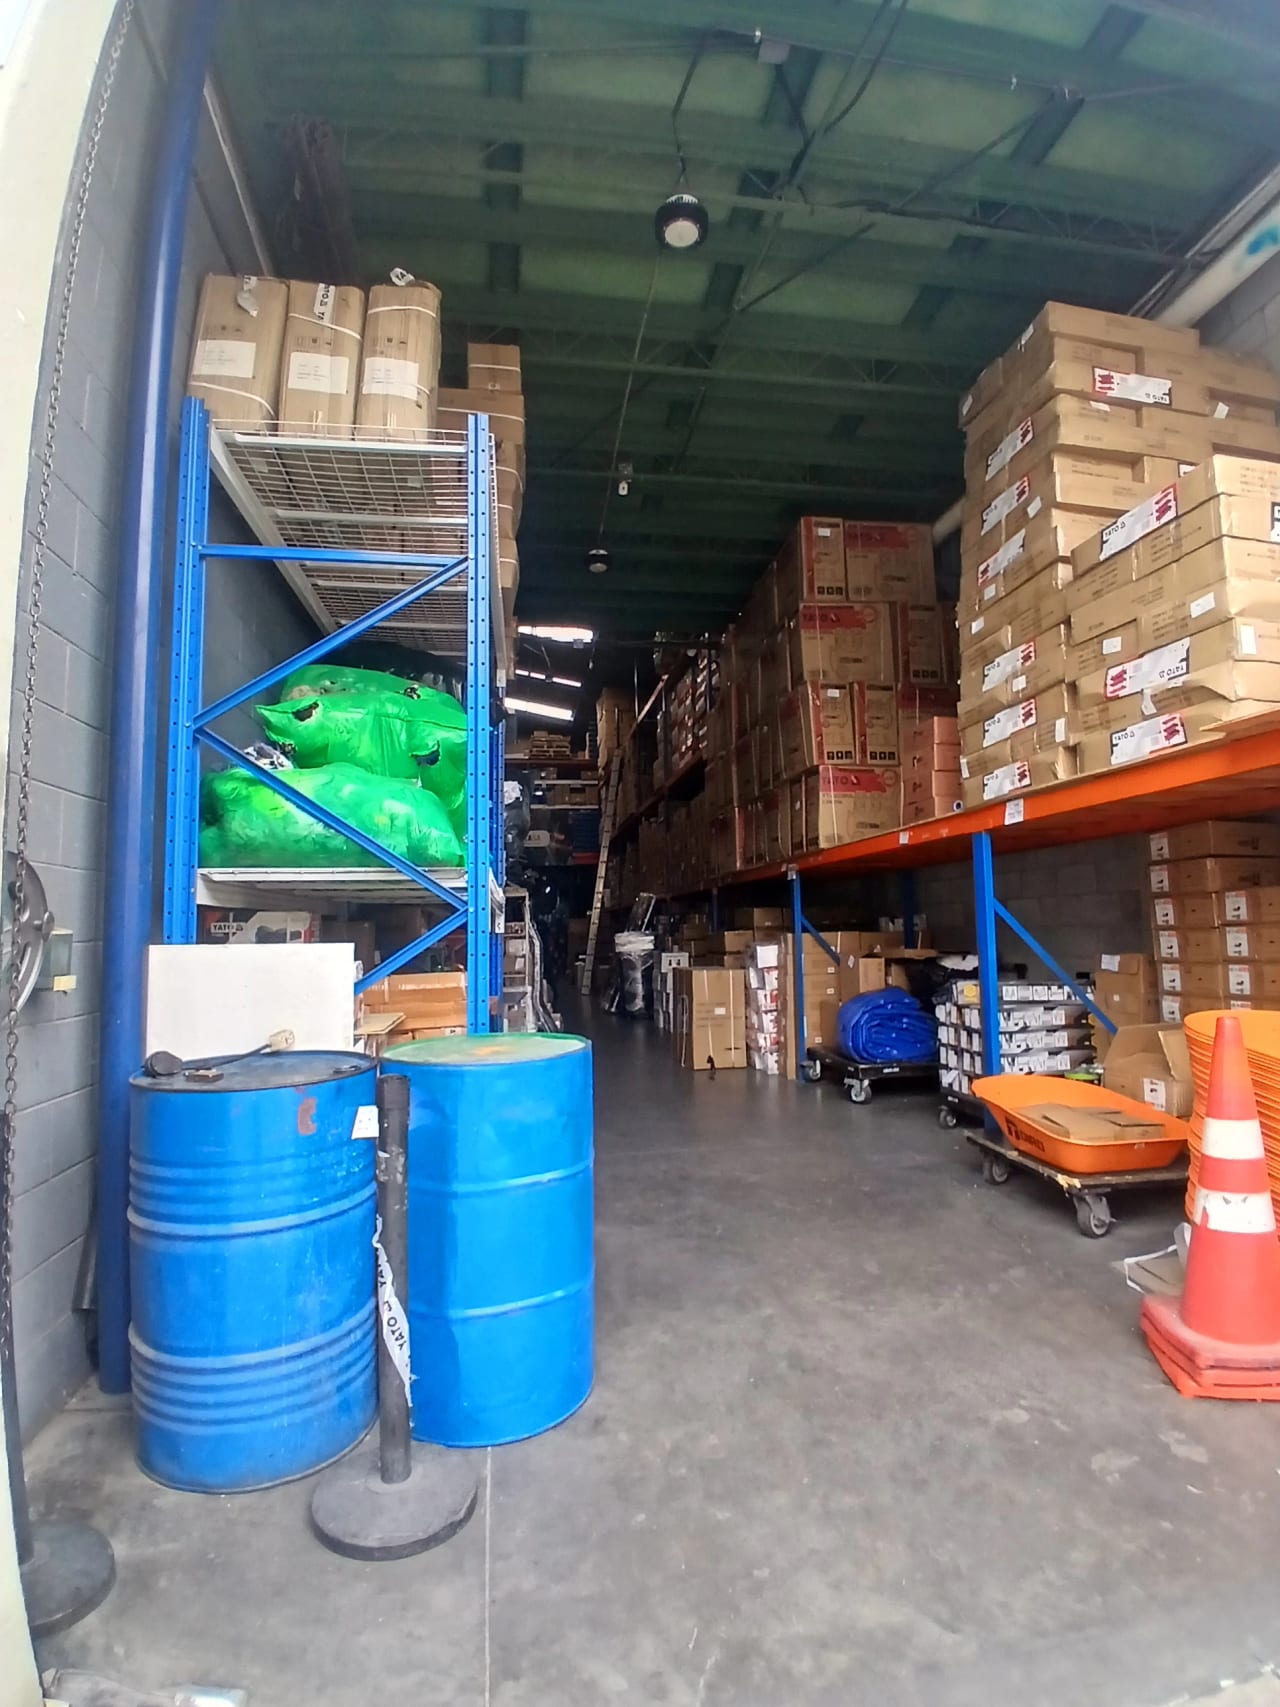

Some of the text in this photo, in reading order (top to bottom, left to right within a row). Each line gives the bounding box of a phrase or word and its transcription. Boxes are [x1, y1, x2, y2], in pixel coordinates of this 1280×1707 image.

[1166, 664, 1185, 676] YATO
[1114, 732, 1129, 741] YATO
[387, 1316, 407, 1351] YATO
